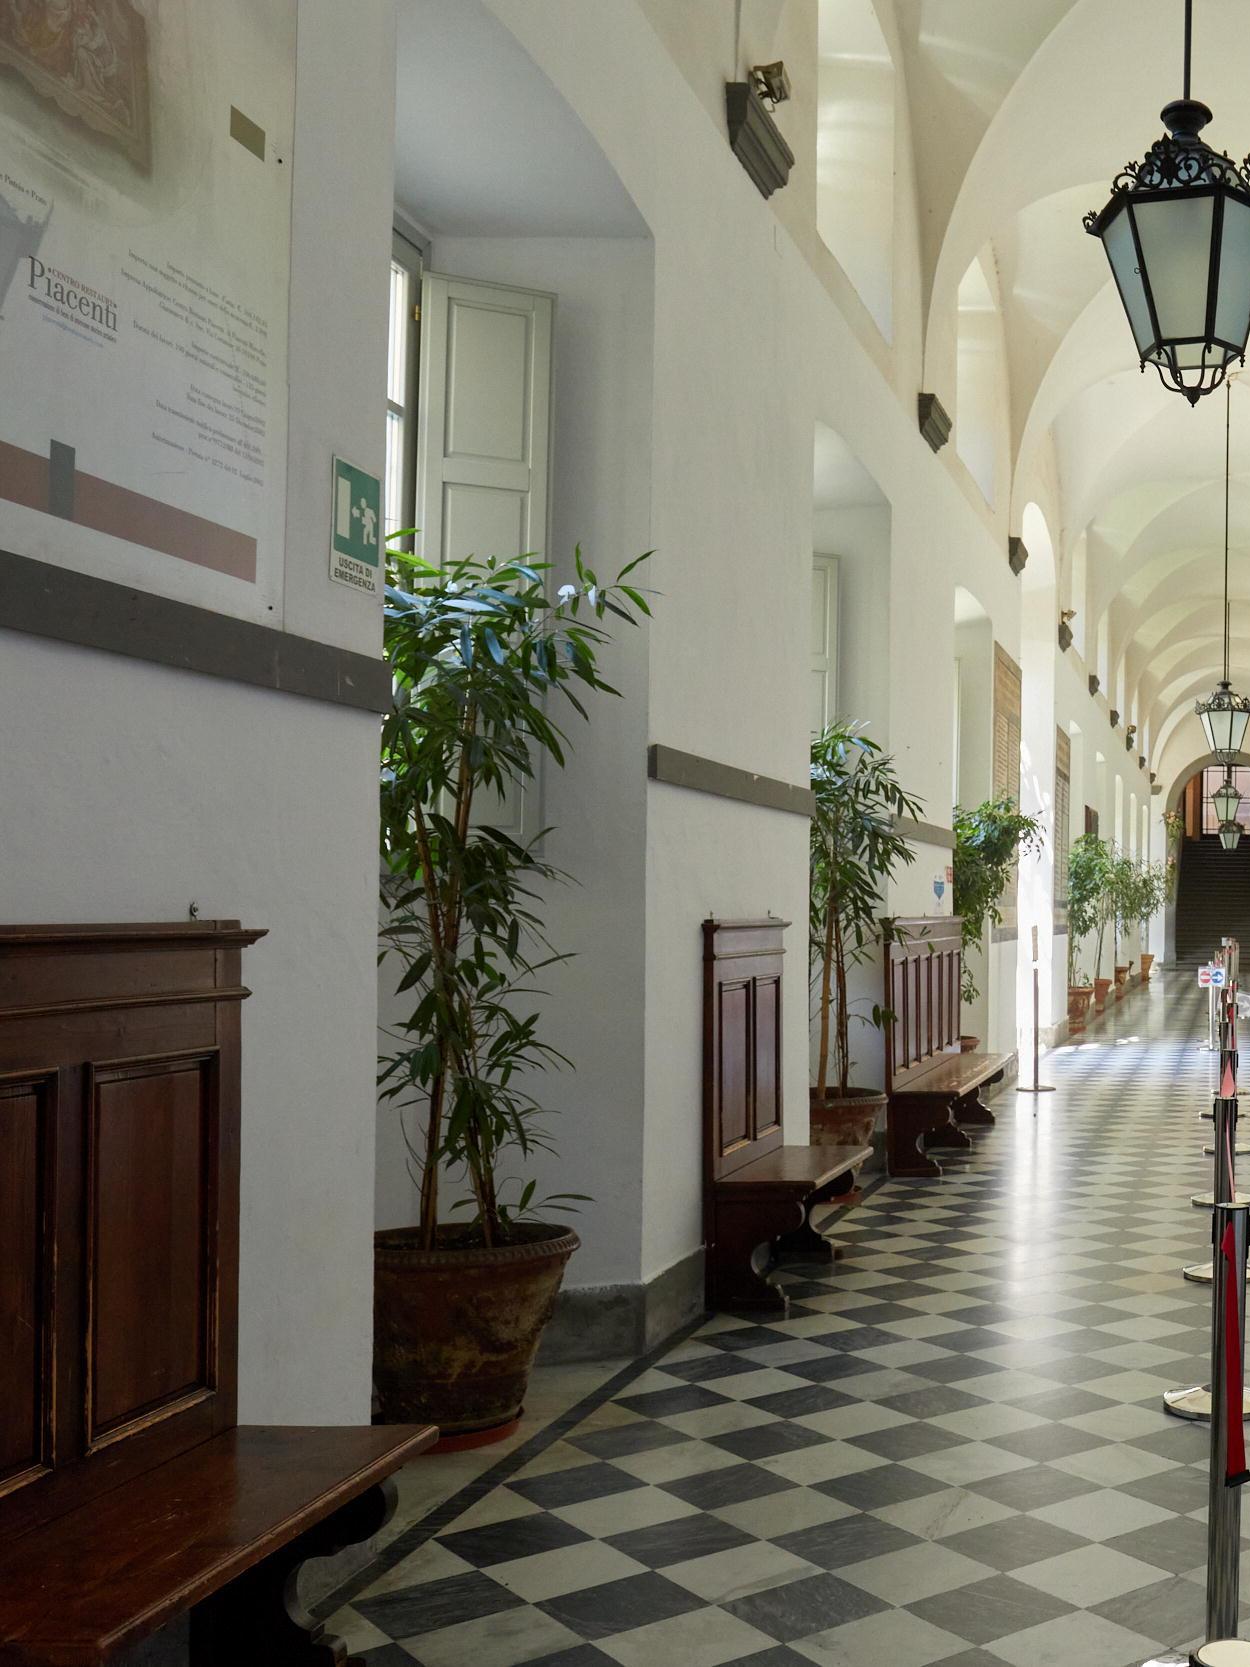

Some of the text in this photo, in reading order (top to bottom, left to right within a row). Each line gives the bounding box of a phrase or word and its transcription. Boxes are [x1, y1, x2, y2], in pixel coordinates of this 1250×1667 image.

[52, 268, 81, 289] CENTRO
[28, 255, 118, 332] Piacenti
[339, 557, 372, 579] USCITA DI
[335, 568, 376, 592] EMERGENZA
